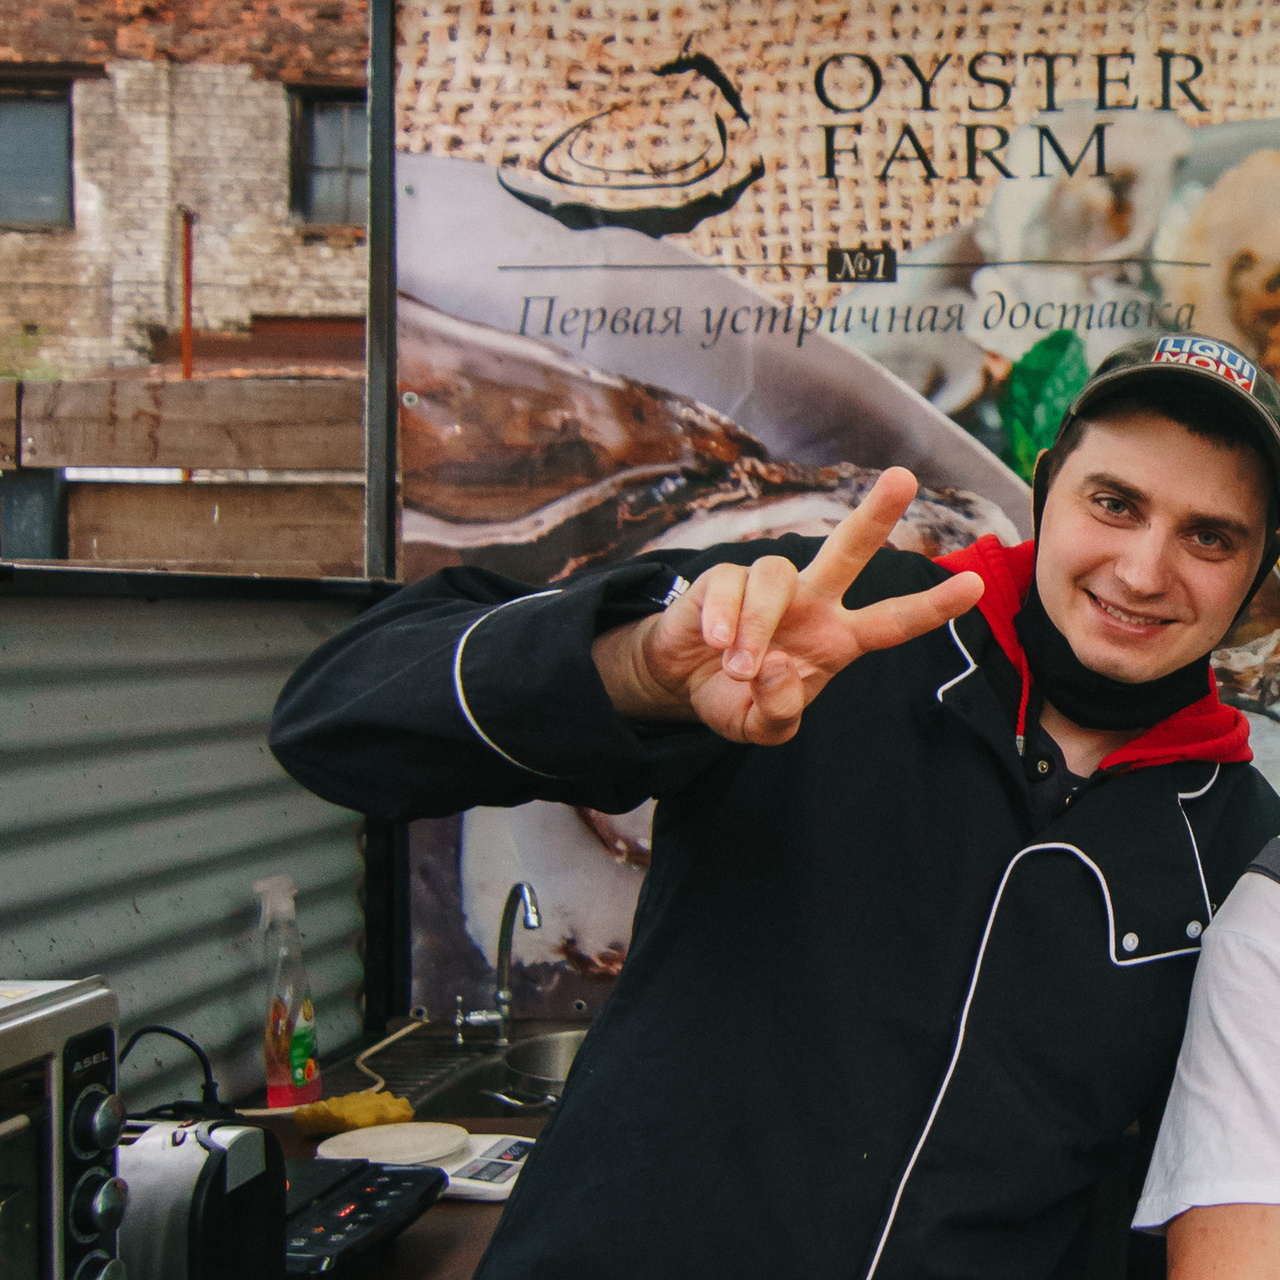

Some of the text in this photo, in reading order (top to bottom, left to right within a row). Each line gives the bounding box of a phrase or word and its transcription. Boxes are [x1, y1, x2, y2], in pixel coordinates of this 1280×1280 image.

[813, 48, 1207, 114] OYSTER
[819, 122, 1114, 179] FARM
[835, 252, 887, 281] №1
[516, 288, 1197, 349] Первая устричная доставка
[1160, 351, 1250, 388] MOLY
[1163, 338, 1249, 377] LIQUI
[72, 1051, 110, 1073] ASEL
